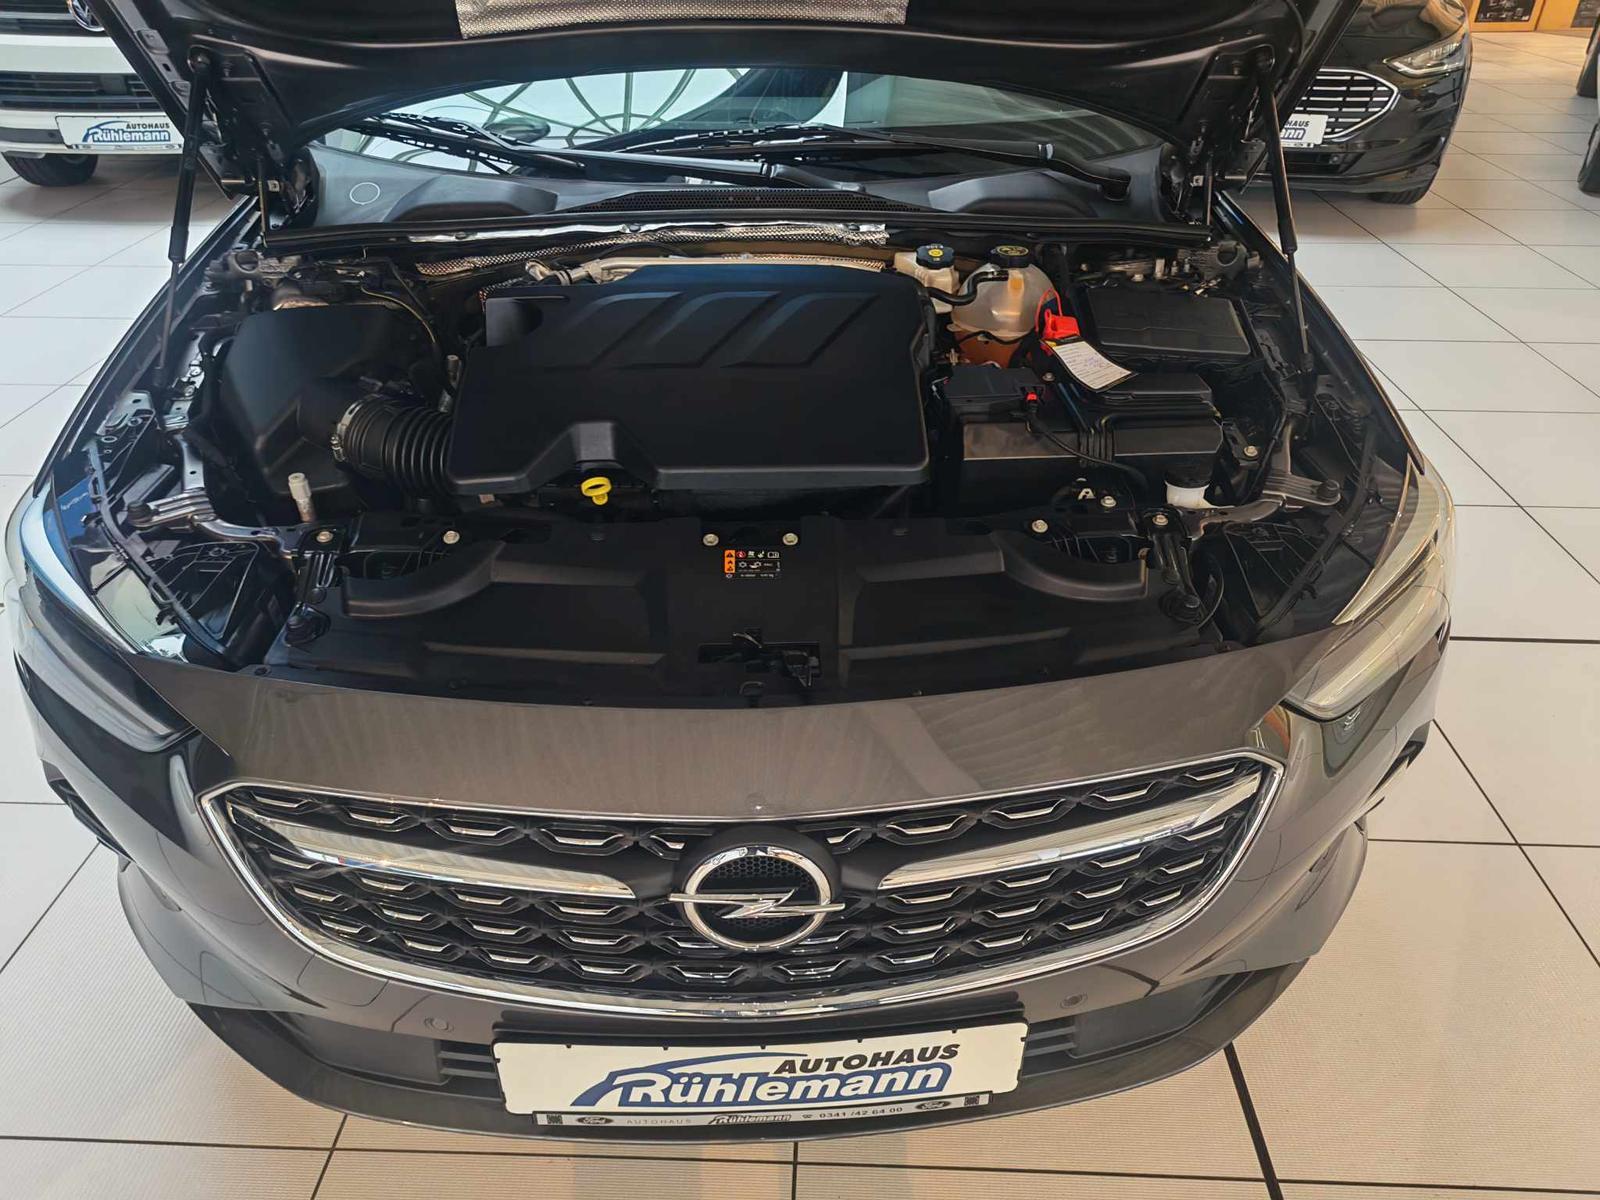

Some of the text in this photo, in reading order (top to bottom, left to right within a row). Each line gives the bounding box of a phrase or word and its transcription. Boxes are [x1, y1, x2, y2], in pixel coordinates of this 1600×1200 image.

[89, 129, 169, 141] Rühlemann
[773, 1043, 960, 1075] AUTOHAUS
[613, 1066, 944, 1104] Rühlemann
[713, 1114, 791, 1125] Rühlemann
